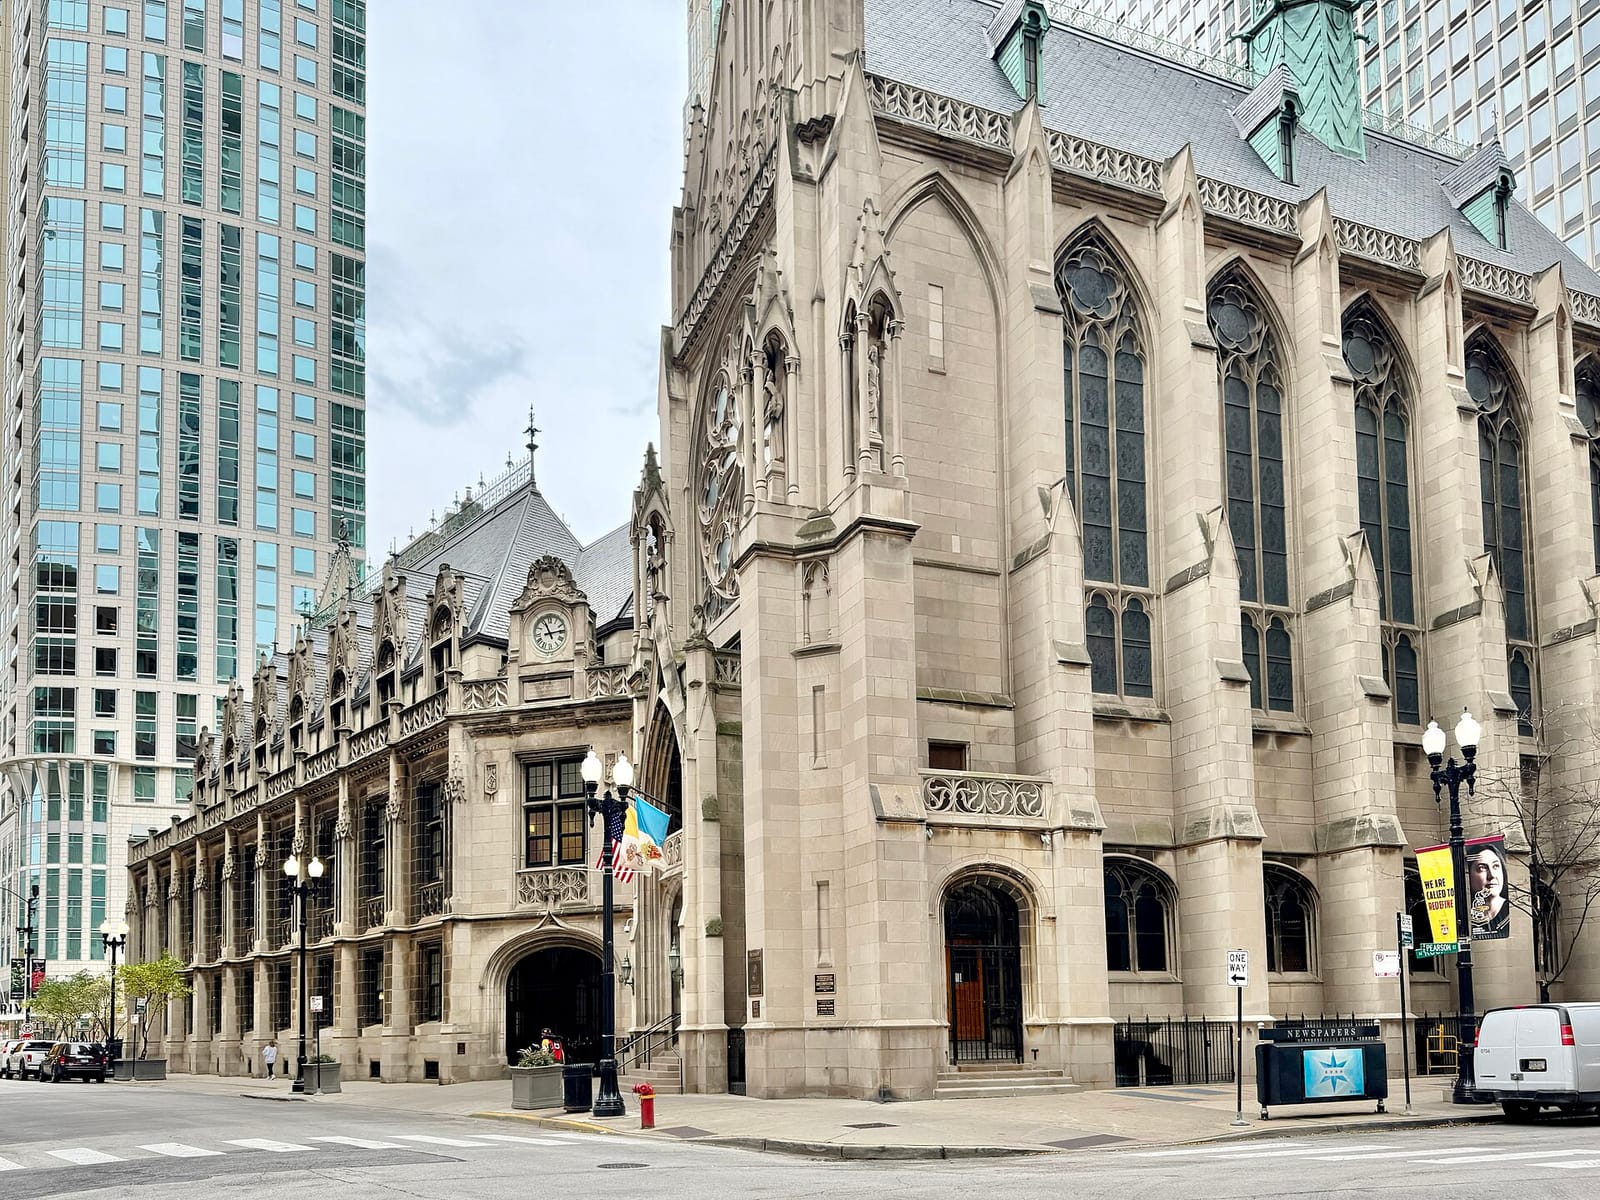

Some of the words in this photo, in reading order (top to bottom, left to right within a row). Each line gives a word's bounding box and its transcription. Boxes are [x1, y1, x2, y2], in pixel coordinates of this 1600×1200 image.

[1424, 880, 1434, 889] WE
[1434, 878, 1446, 887] ARE
[1426, 889, 1447, 900] CALLED
[1425, 943, 1451, 952] PEARSON
[1229, 953, 1246, 963] ONE
[1229, 963, 1246, 973] WAY
[1287, 1028, 1356, 1039] NEWSPAPERS
